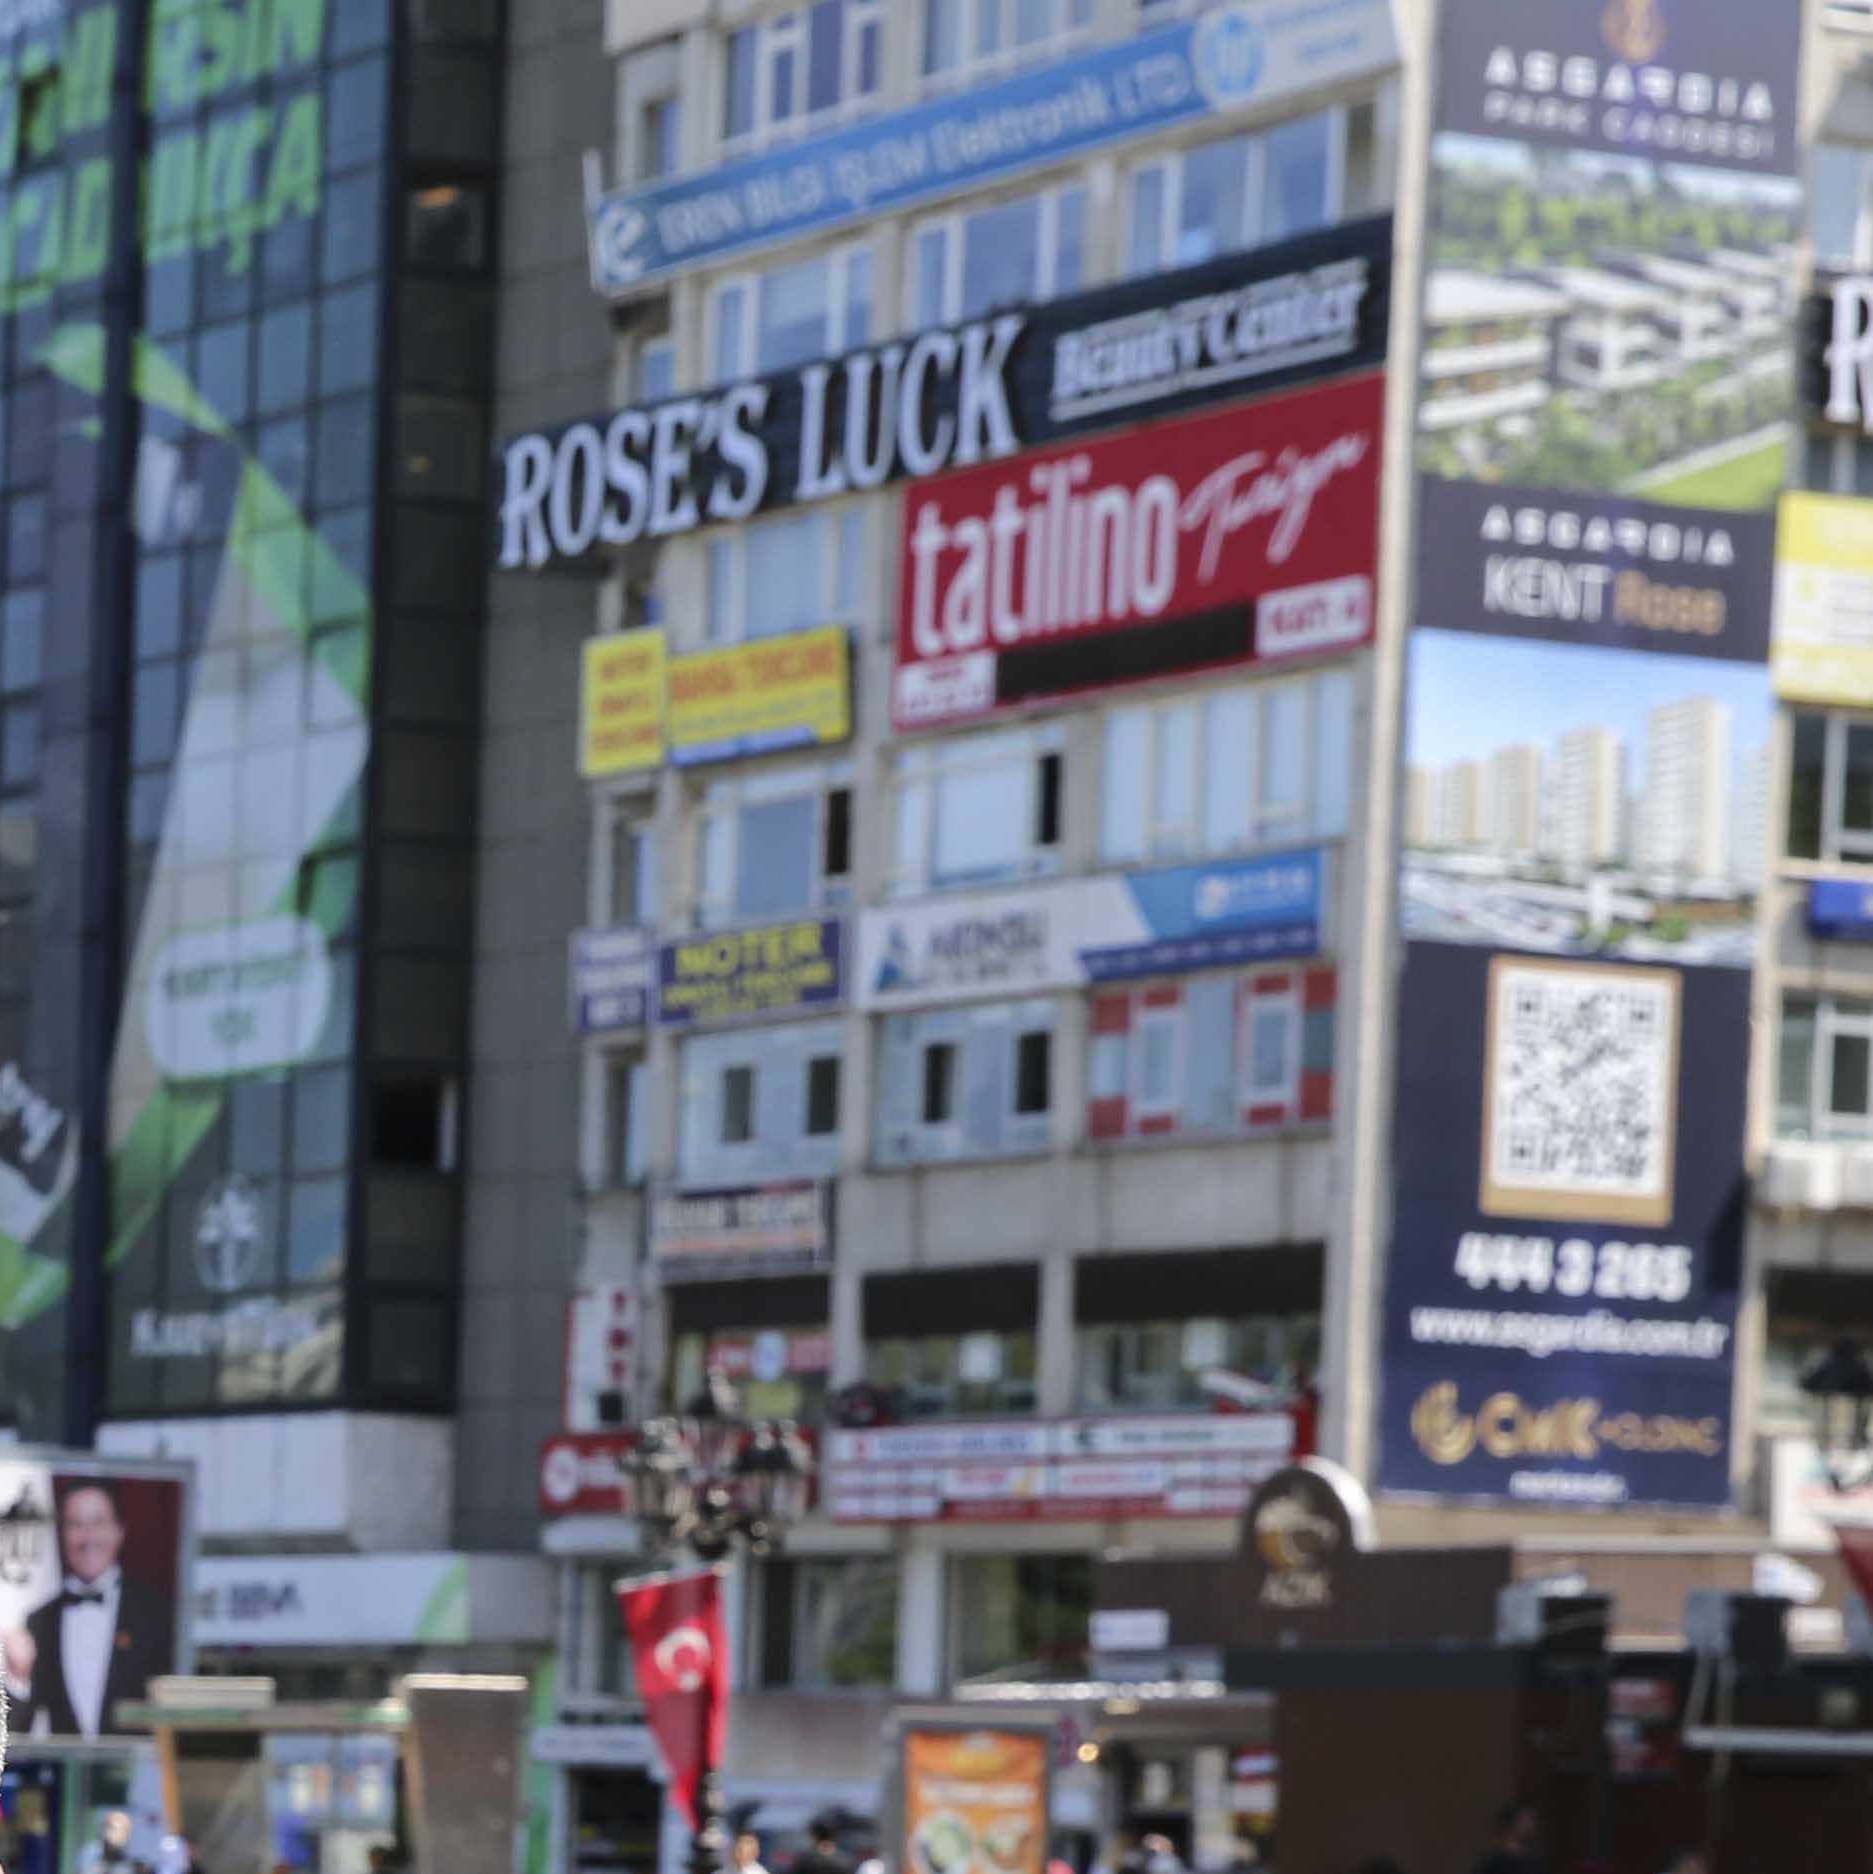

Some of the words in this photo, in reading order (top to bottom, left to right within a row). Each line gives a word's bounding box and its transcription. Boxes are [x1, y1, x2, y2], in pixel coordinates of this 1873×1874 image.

[498, 383, 768, 568] ROSE'S
[794, 315, 1024, 499] LUCK
[912, 454, 1179, 656] tatilino
[1483, 553, 1613, 623] KENT
